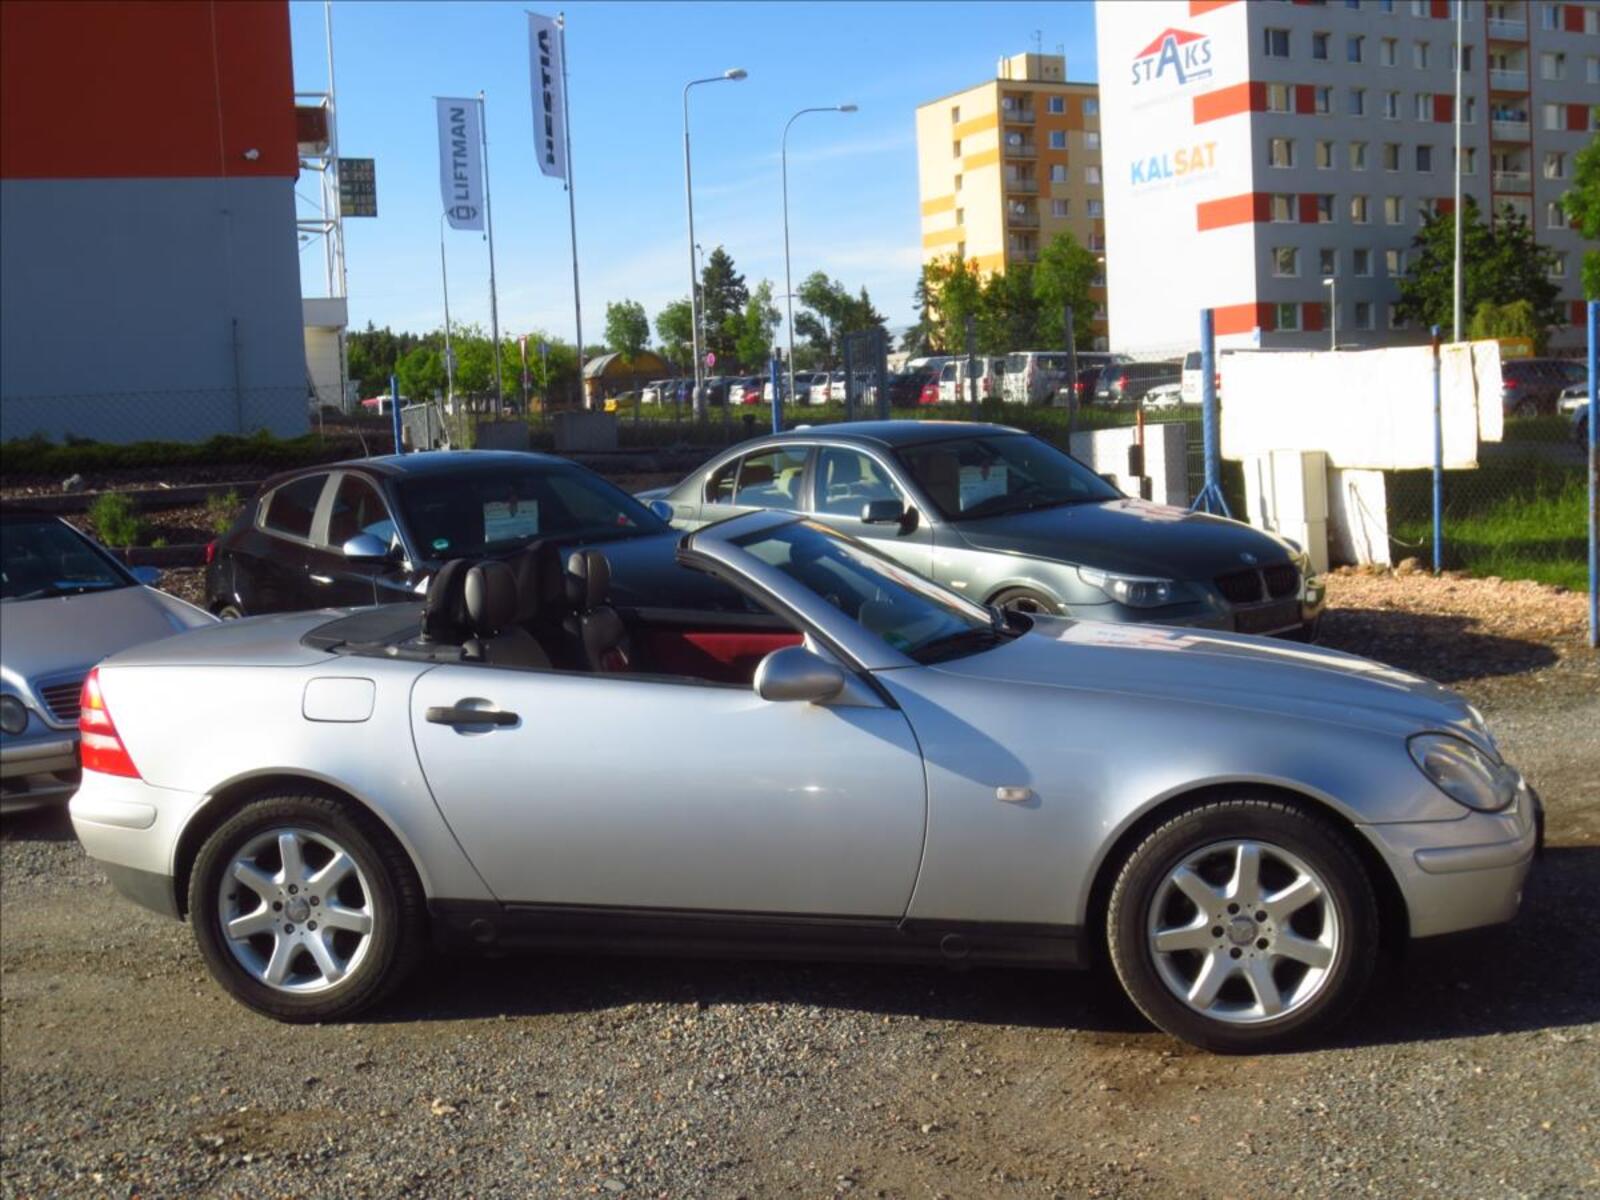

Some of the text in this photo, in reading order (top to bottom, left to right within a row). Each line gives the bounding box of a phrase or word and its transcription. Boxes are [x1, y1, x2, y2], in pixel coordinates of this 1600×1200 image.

[537, 29, 556, 165] HESTIA
[1131, 37, 1212, 86] STAKS
[450, 107, 470, 201] LIFTMAN
[1131, 141, 1217, 186] KALSAT
